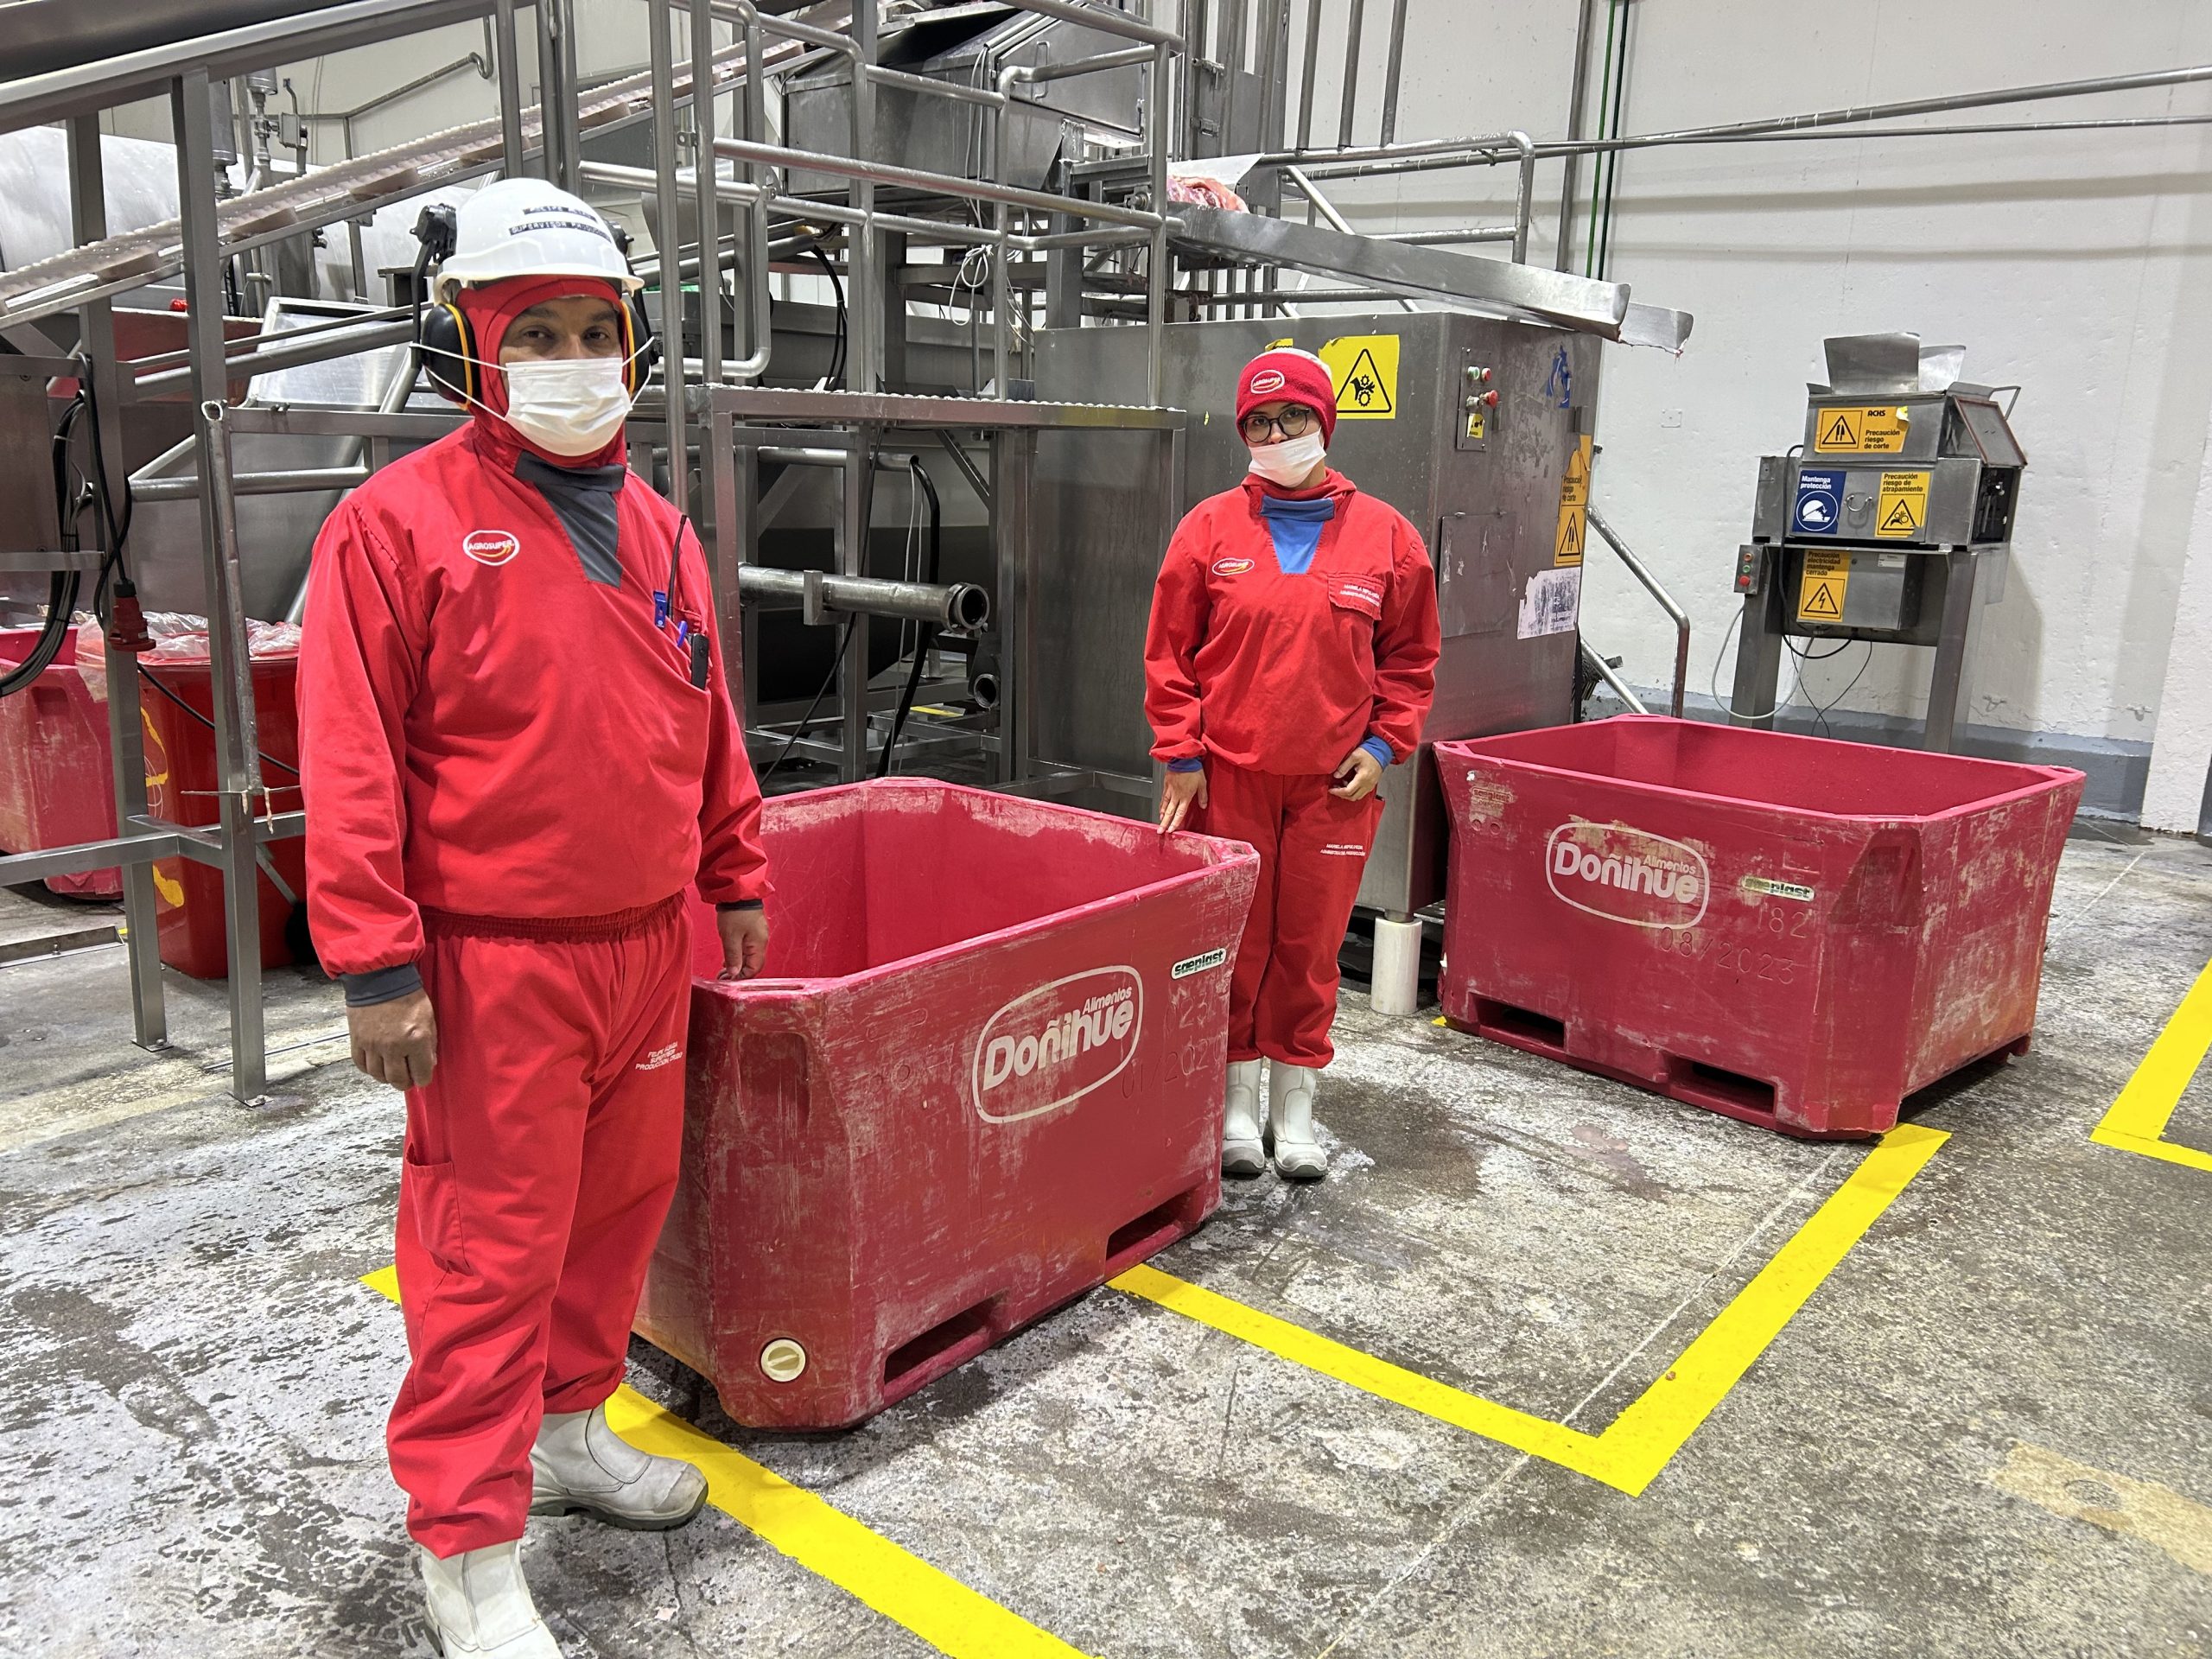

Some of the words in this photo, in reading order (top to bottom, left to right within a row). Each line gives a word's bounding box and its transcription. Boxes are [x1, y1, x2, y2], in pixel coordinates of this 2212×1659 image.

[1800, 481, 1832, 490] protección
[1802, 475, 1831, 484] Mantenga
[1554, 842, 1699, 904] Doñihue
[1643, 855, 1696, 875] Alimentos
[1082, 986, 1133, 1015] Alimentos
[983, 1000, 1135, 1091] Doñihue
